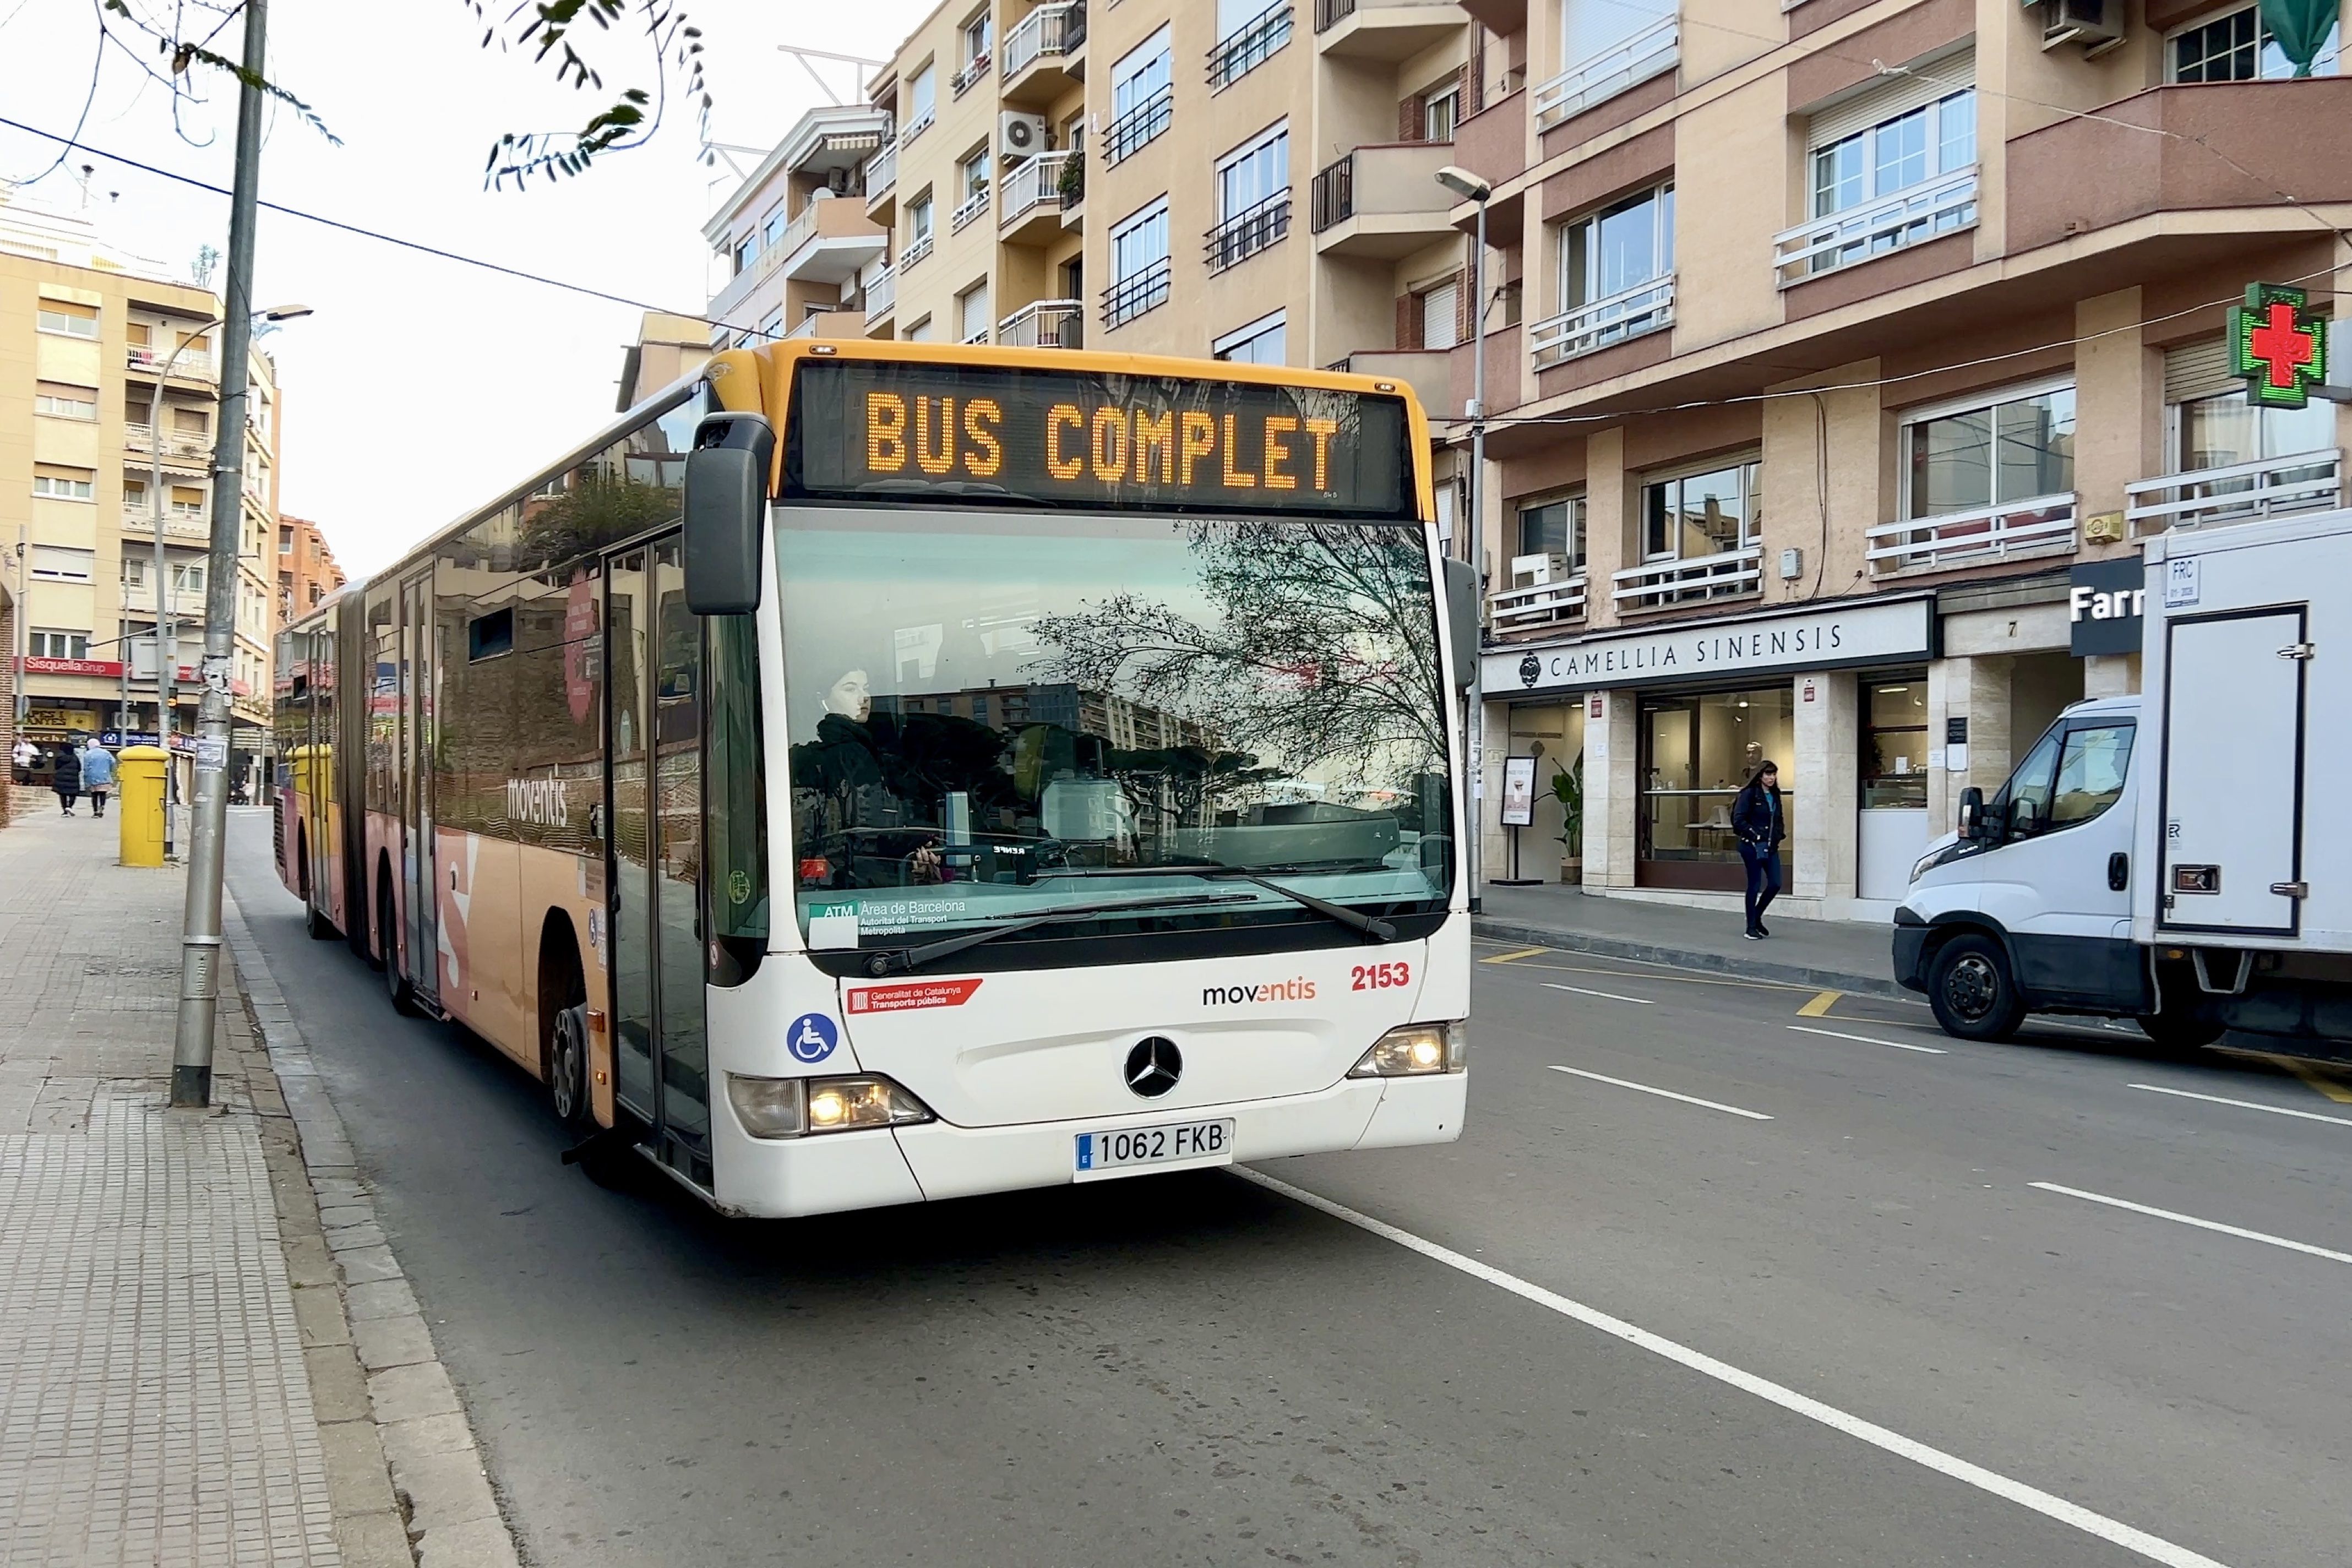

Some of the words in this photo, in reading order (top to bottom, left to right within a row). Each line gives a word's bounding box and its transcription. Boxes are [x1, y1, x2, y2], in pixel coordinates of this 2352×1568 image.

[868, 392, 1000, 476] BUS
[1048, 404, 1338, 491] COMPLET
[2173, 560, 2193, 580] FRC
[2008, 620, 2017, 638] 7
[1550, 645, 1676, 677] CAMELLIA
[1697, 624, 1841, 662] SINENSIS
[508, 763, 568, 827] moventis
[824, 905, 853, 918] ATM
[861, 900, 888, 916] Àrea
[891, 902, 906, 914] de
[909, 899, 966, 914] Barcelona
[861, 916, 895, 926] Autoritat
[896, 914, 909, 924] del
[910, 914, 948, 924] Transport
[861, 925, 906, 937] Metropolità
[870, 990, 912, 1001] Generalitat
[924, 986, 961, 996] Catalunya
[1202, 975, 1316, 1006] moventis
[1351, 962, 1409, 992] 2153
[870, 999, 916, 1009] Transports
[917, 995, 946, 1008] públics
[1081, 1155, 1087, 1163] E
[1102, 1130, 1165, 1162] 1062
[1175, 1124, 1222, 1155] FKB
